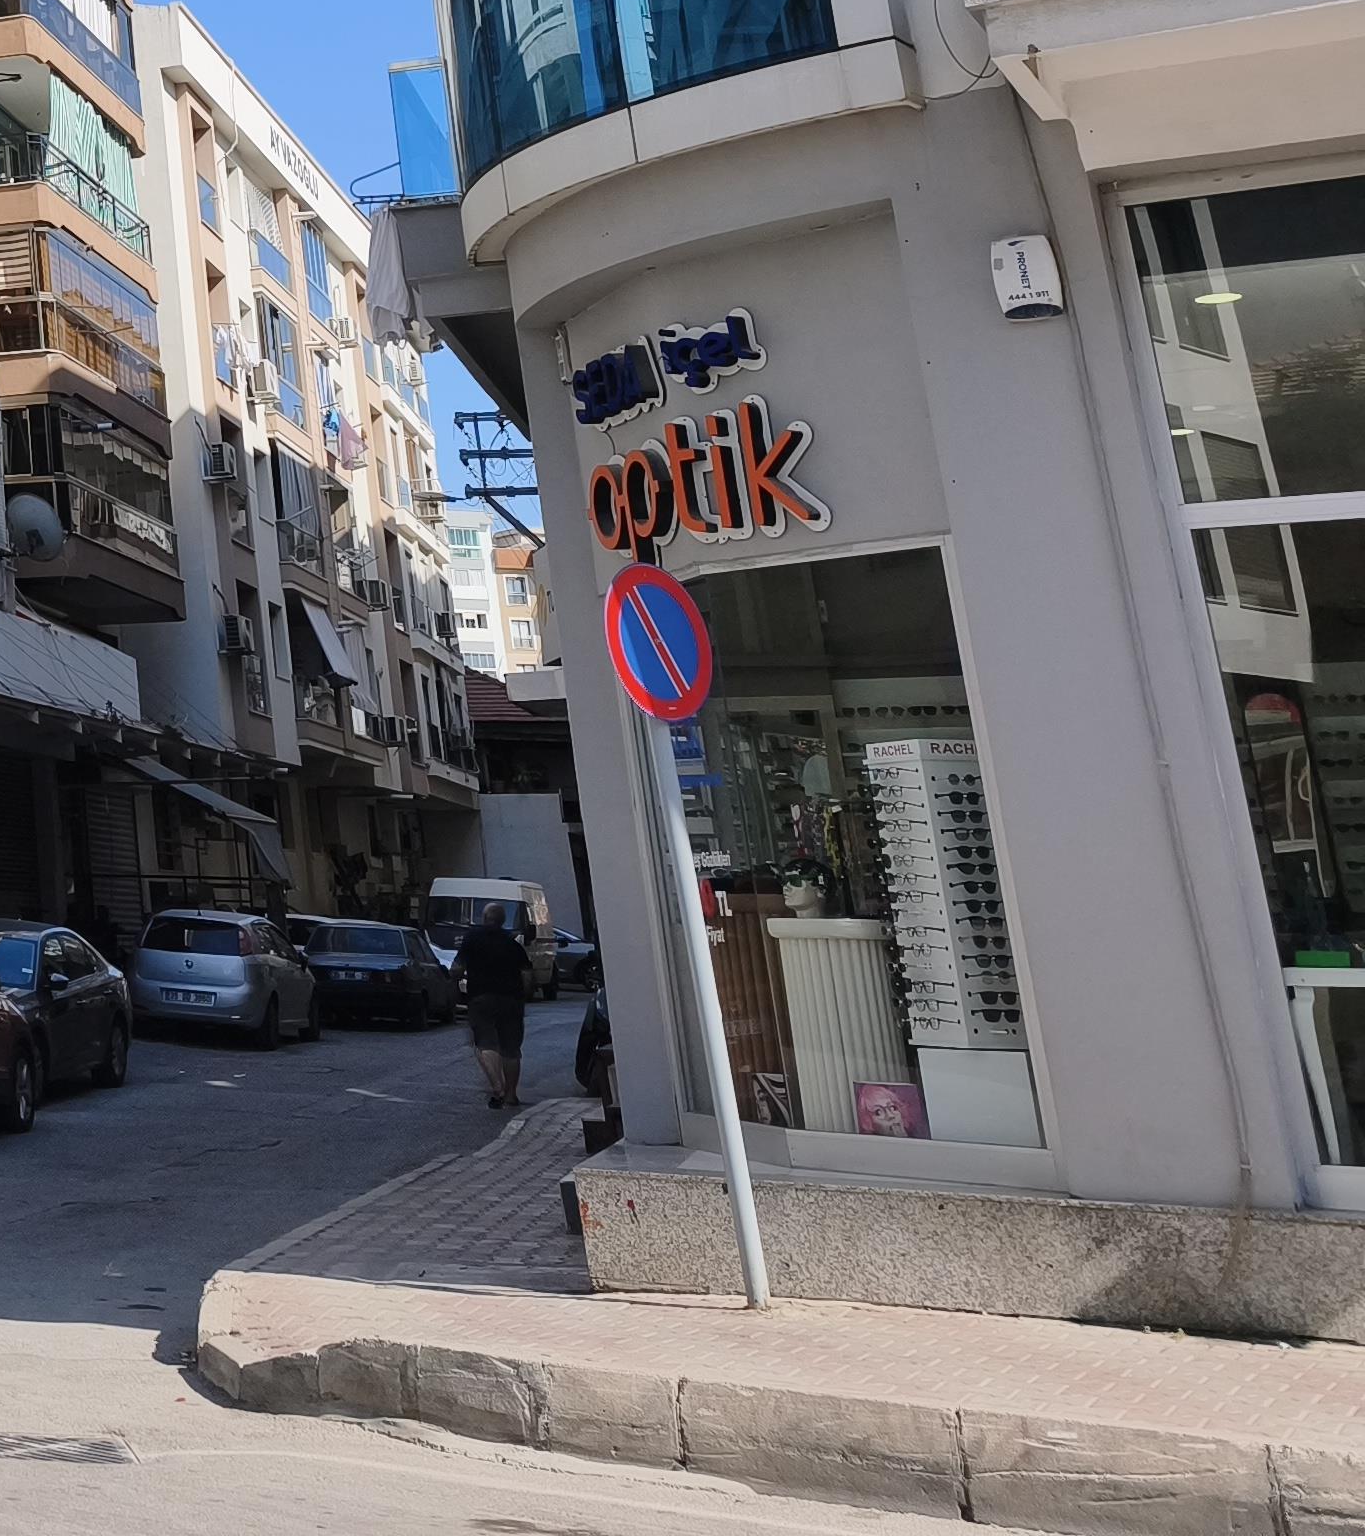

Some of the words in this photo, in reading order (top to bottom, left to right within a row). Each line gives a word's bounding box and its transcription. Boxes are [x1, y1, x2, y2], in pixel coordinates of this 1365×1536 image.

[1015, 251, 1031, 290] PRONET
[587, 400, 818, 564] optik
[872, 743, 915, 758] RACHEL
[714, 890, 733, 917] TL
